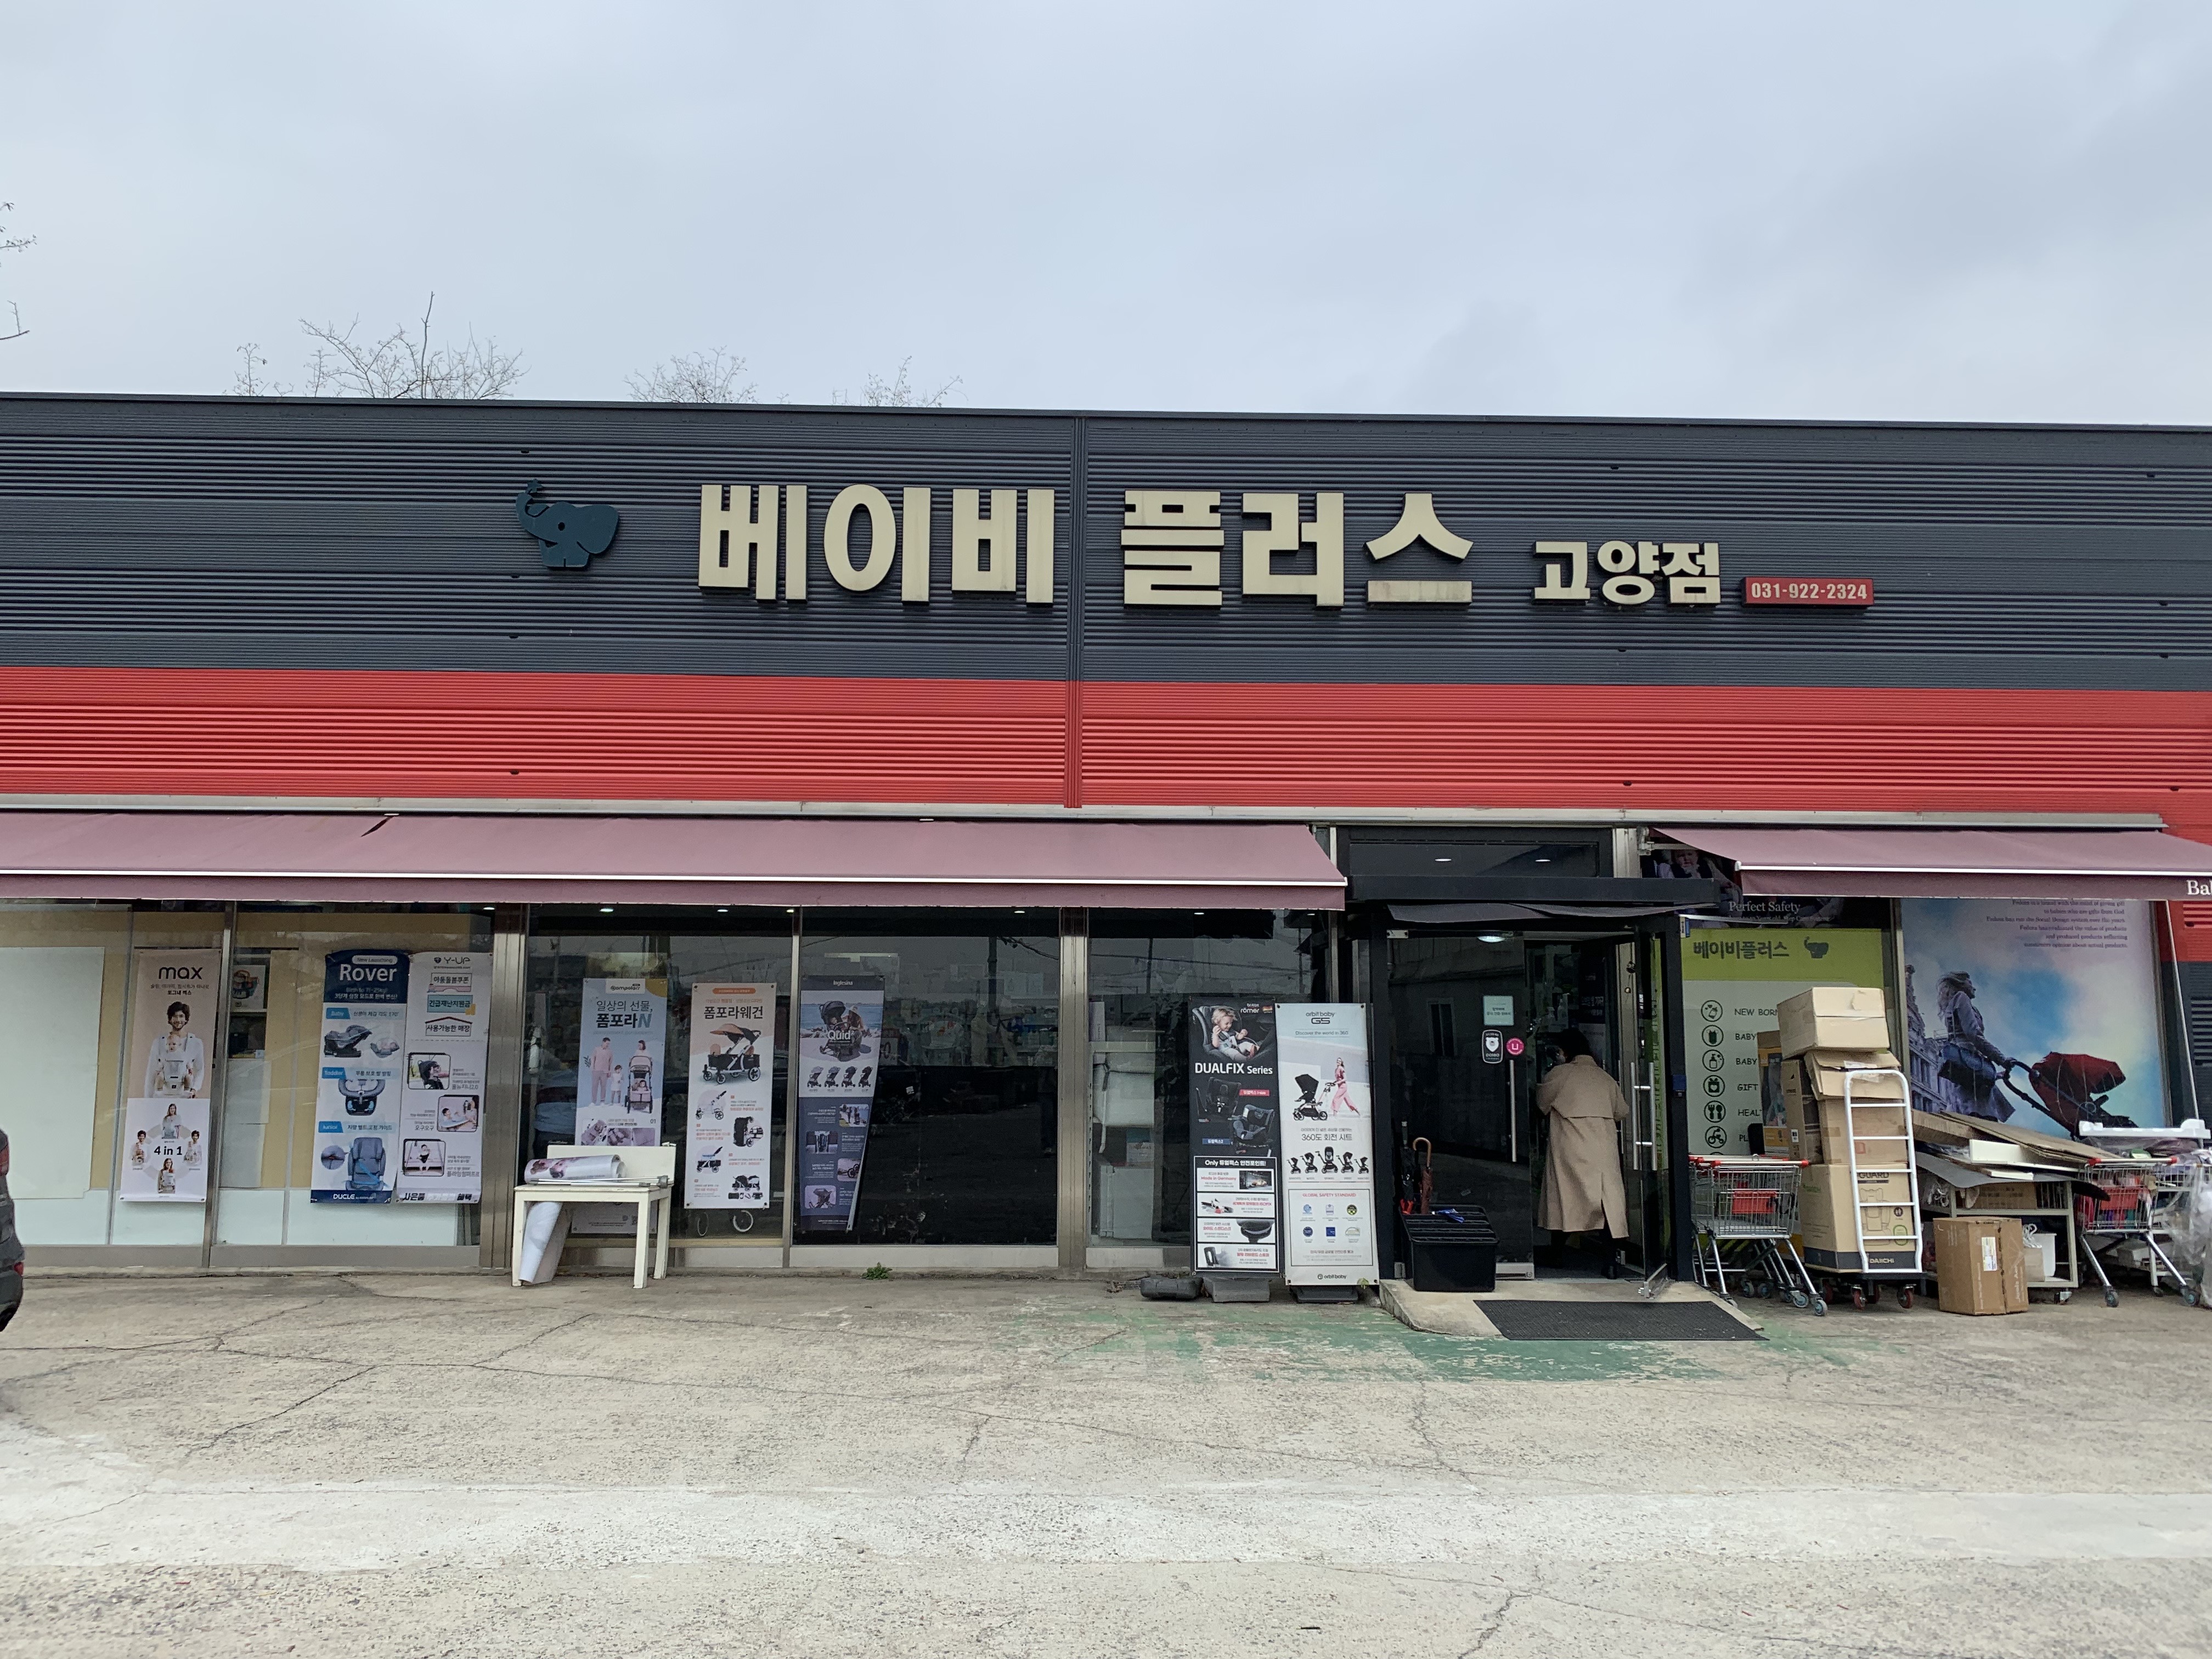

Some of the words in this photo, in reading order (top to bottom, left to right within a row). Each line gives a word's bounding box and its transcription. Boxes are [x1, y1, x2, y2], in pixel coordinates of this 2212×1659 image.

[698, 483, 1054, 603] 베이비
[1120, 490, 1474, 607] 플러스
[1534, 540, 1720, 604] 고양점
[1751, 582, 1867, 599] 031-922-2324
[2187, 879, 2212, 895] Ba
[1729, 901, 1765, 912] Perfect
[1768, 901, 1801, 914] Safety
[1693, 941, 1790, 959] 베이비플러스
[158, 967, 203, 980] max
[340, 964, 397, 981] Rover
[596, 1000, 626, 1012] 일상의
[630, 1000, 653, 1013] 선물,
[704, 1006, 763, 1019] 폼포라웨건
[596, 1013, 652, 1028] 폼포라N
[426, 1024, 457, 1032] 사용가능한
[1195, 1063, 1245, 1074] DUALFIX
[1246, 1065, 1273, 1074] Series
[154, 1146, 161, 1155] 4
[163, 1146, 173, 1155] in
[176, 1146, 183, 1155] 1
[402, 1193, 425, 1201] 사은품
